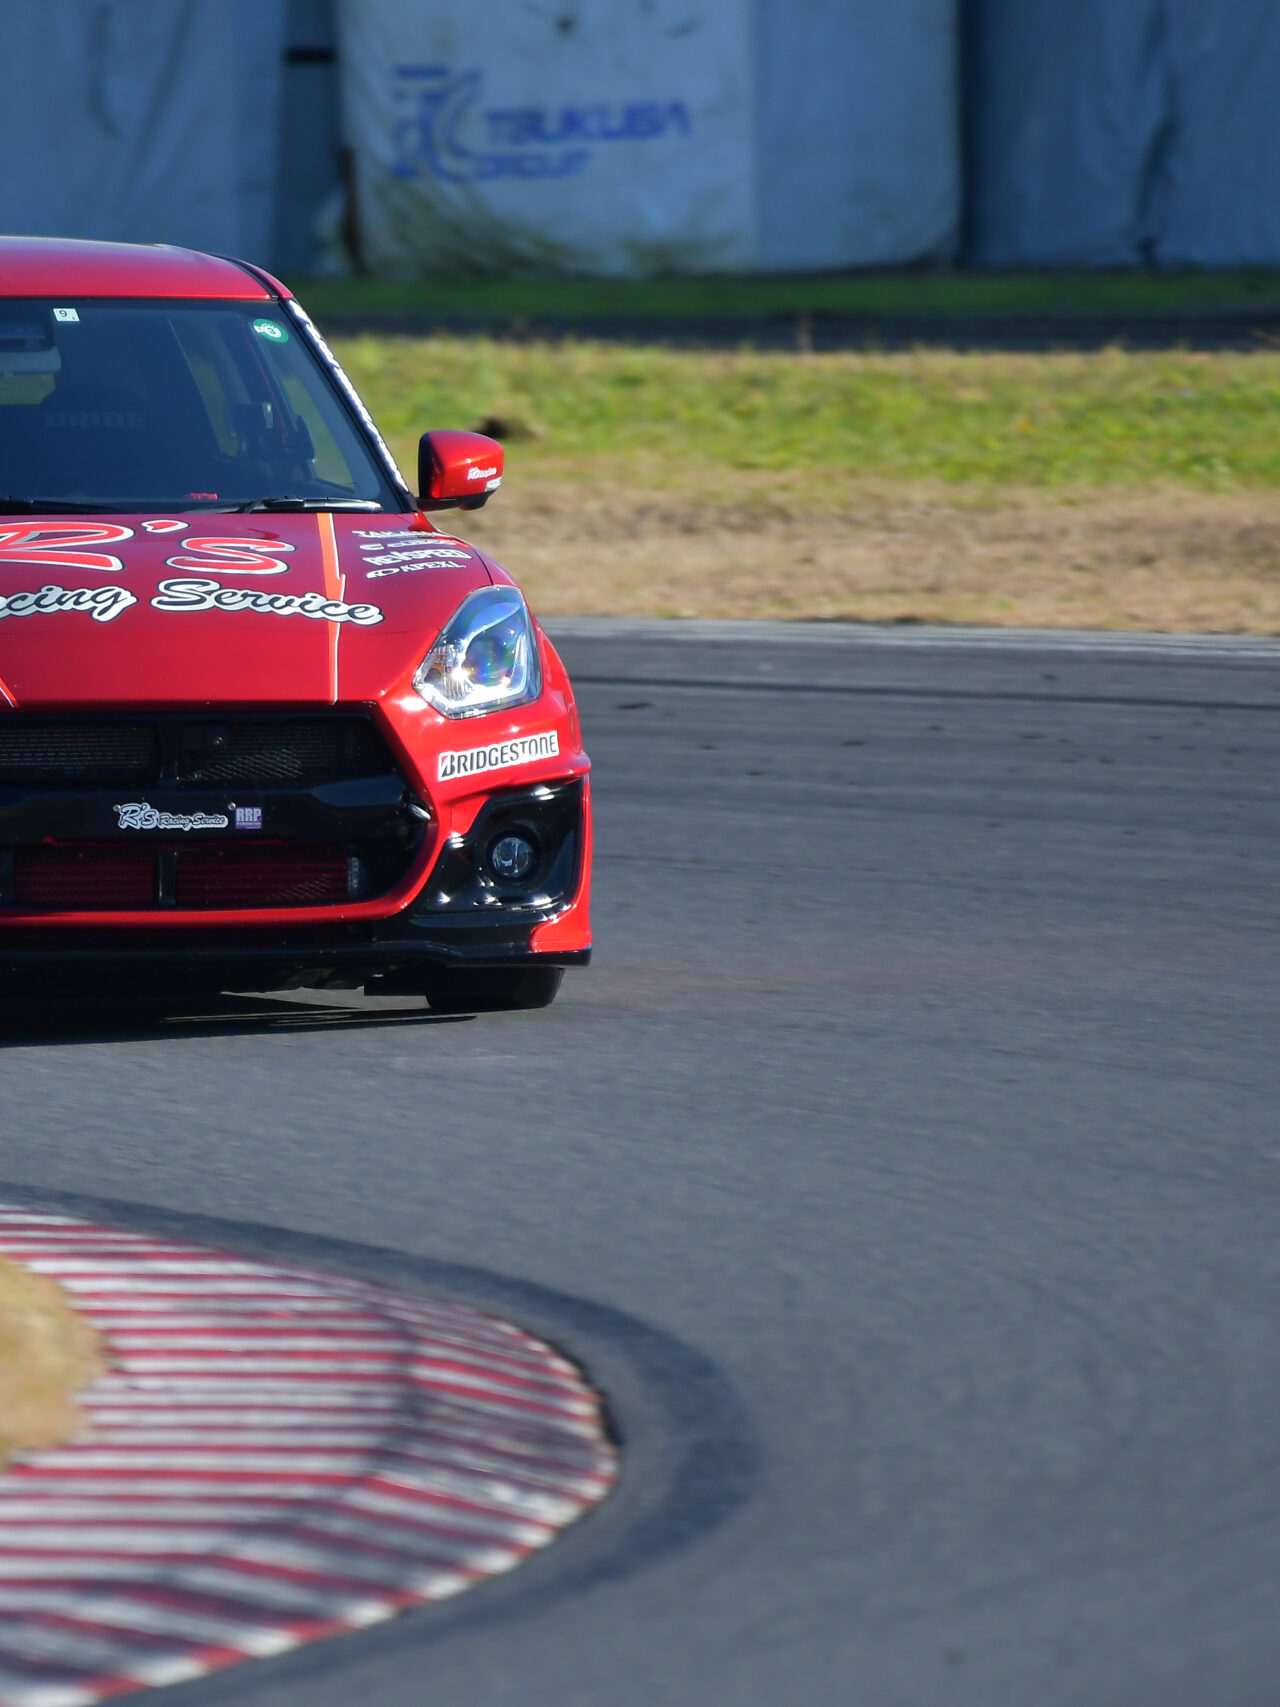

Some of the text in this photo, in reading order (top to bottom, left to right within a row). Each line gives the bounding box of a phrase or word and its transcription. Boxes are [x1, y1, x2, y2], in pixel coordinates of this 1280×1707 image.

[149, 577, 386, 626] Service
[440, 733, 558, 778] BRIDGESTONE
[158, 812, 193, 831] Racing
[192, 813, 228, 829] Service
[235, 808, 263, 822] RRP
